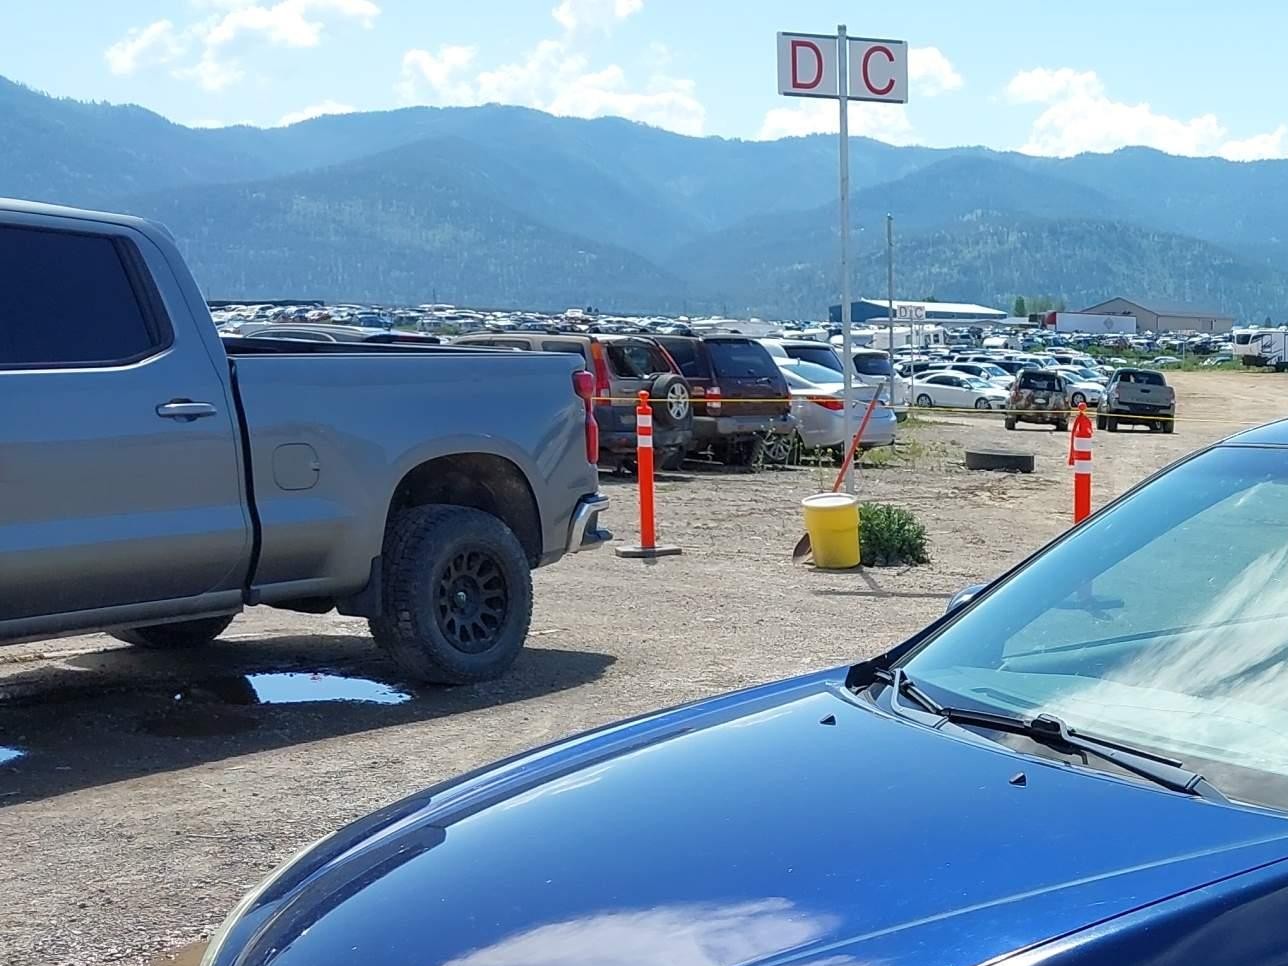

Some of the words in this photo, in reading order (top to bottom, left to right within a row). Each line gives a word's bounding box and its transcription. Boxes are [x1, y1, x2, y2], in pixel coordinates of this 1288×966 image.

[791, 40, 824, 90] D
[861, 45, 896, 96] C
[899, 306, 907, 318] D
[914, 306, 924, 319] C
